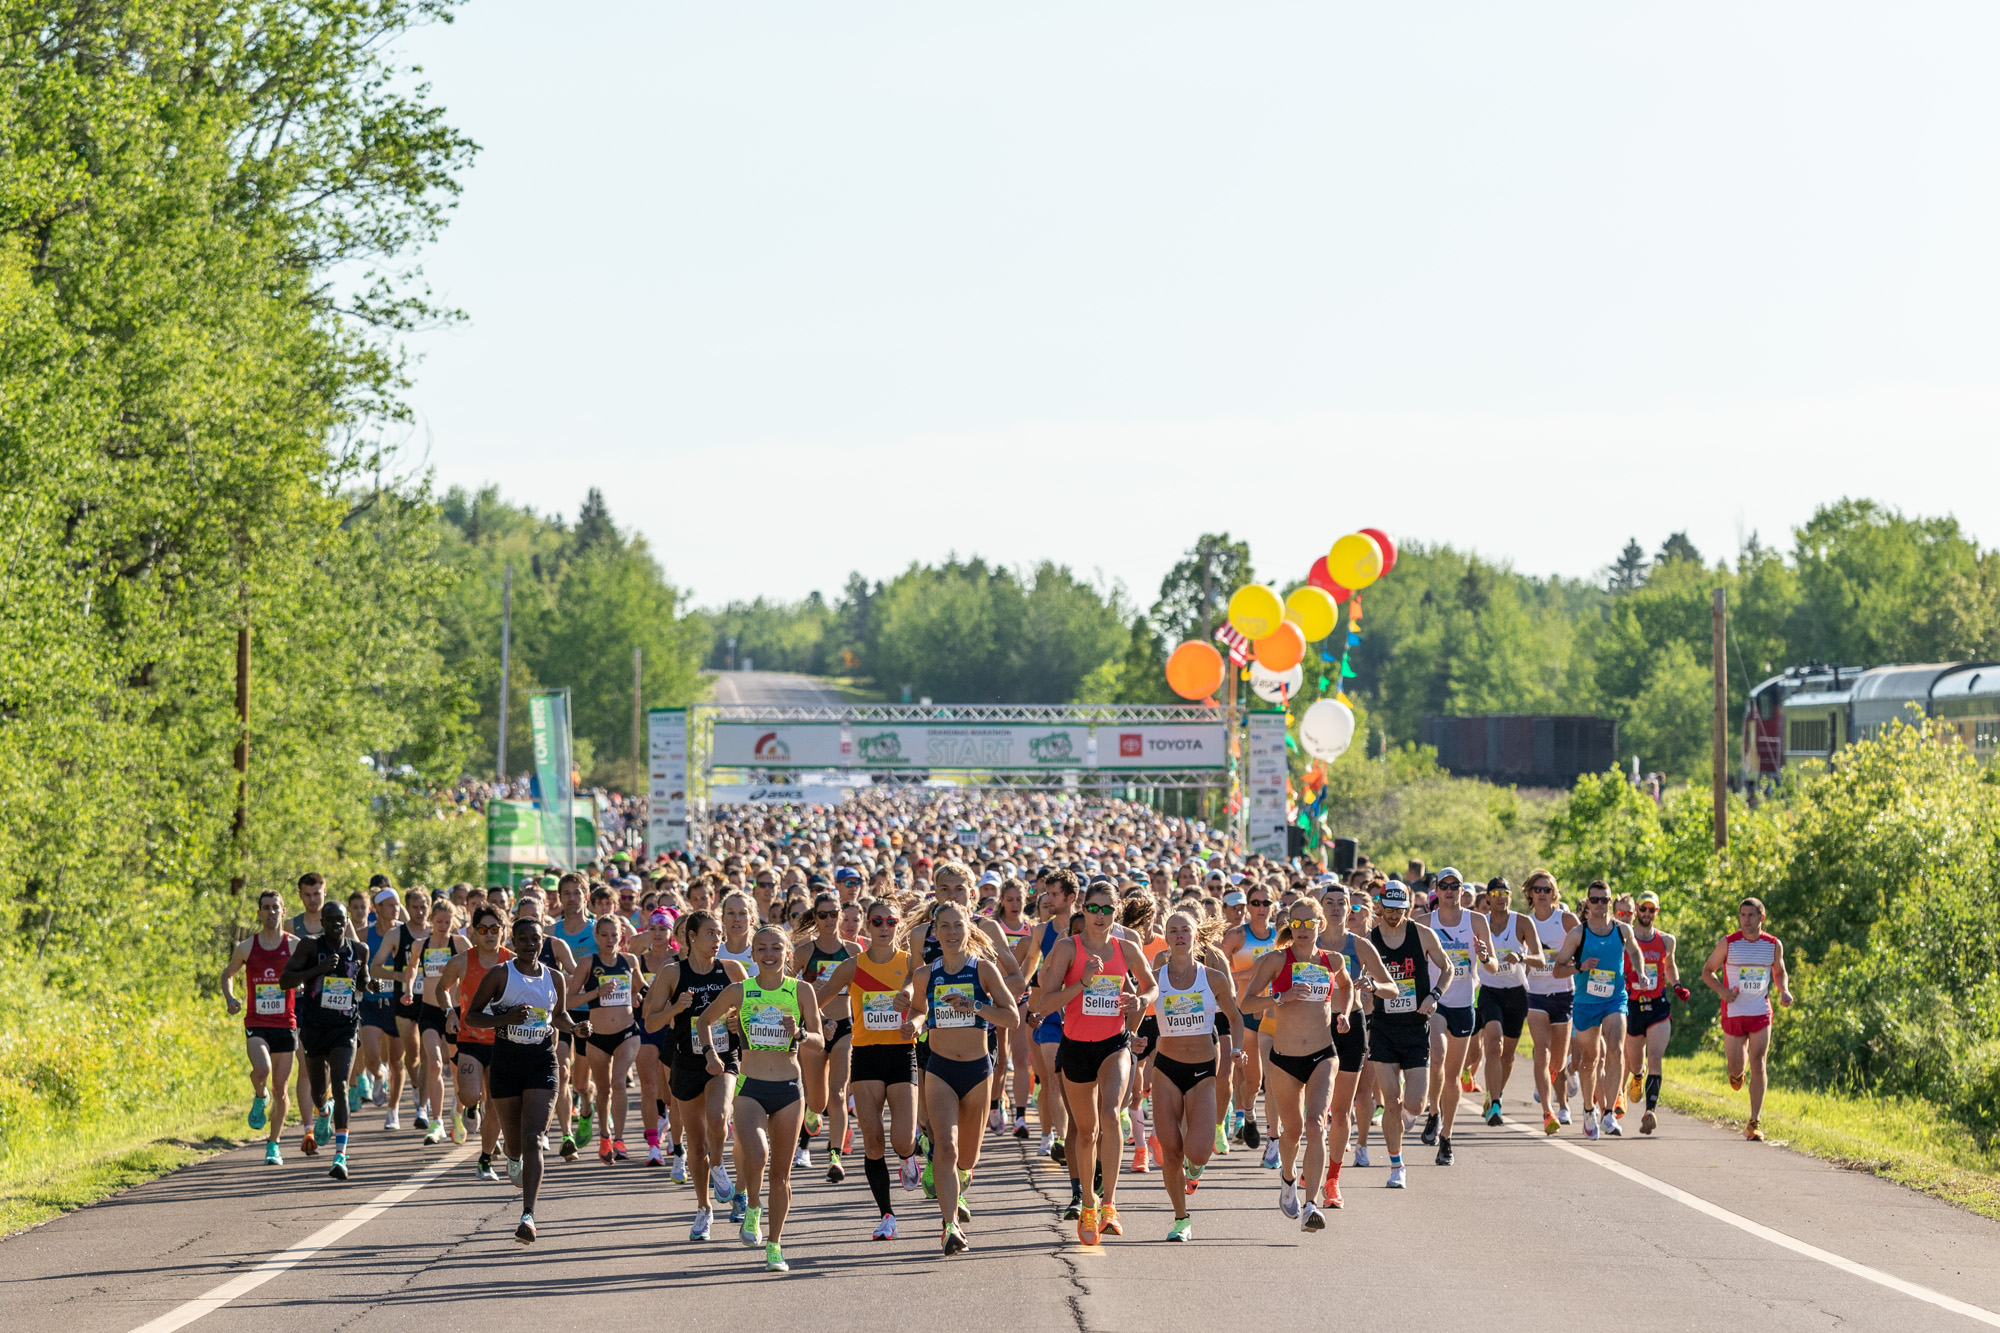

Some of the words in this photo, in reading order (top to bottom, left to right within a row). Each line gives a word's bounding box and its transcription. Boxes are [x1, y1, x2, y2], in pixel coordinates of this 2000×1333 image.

[1148, 739, 1203, 750] TOYOTA
[927, 737, 1014, 765] START
[767, 790, 803, 799] asics
[1593, 984, 1607, 993] 561
[1743, 981, 1761, 990] 6138
[261, 1001, 280, 1010] 4108
[328, 996, 348, 1005] 4427
[1085, 996, 1119, 1009] Sellers
[1390, 998, 1411, 1008] 5275
[867, 1012, 899, 1023] Culver
[1167, 1014, 1205, 1027] Vaughn
[508, 1025, 545, 1039] Wanjiru
[460, 1064, 474, 1074] GO
